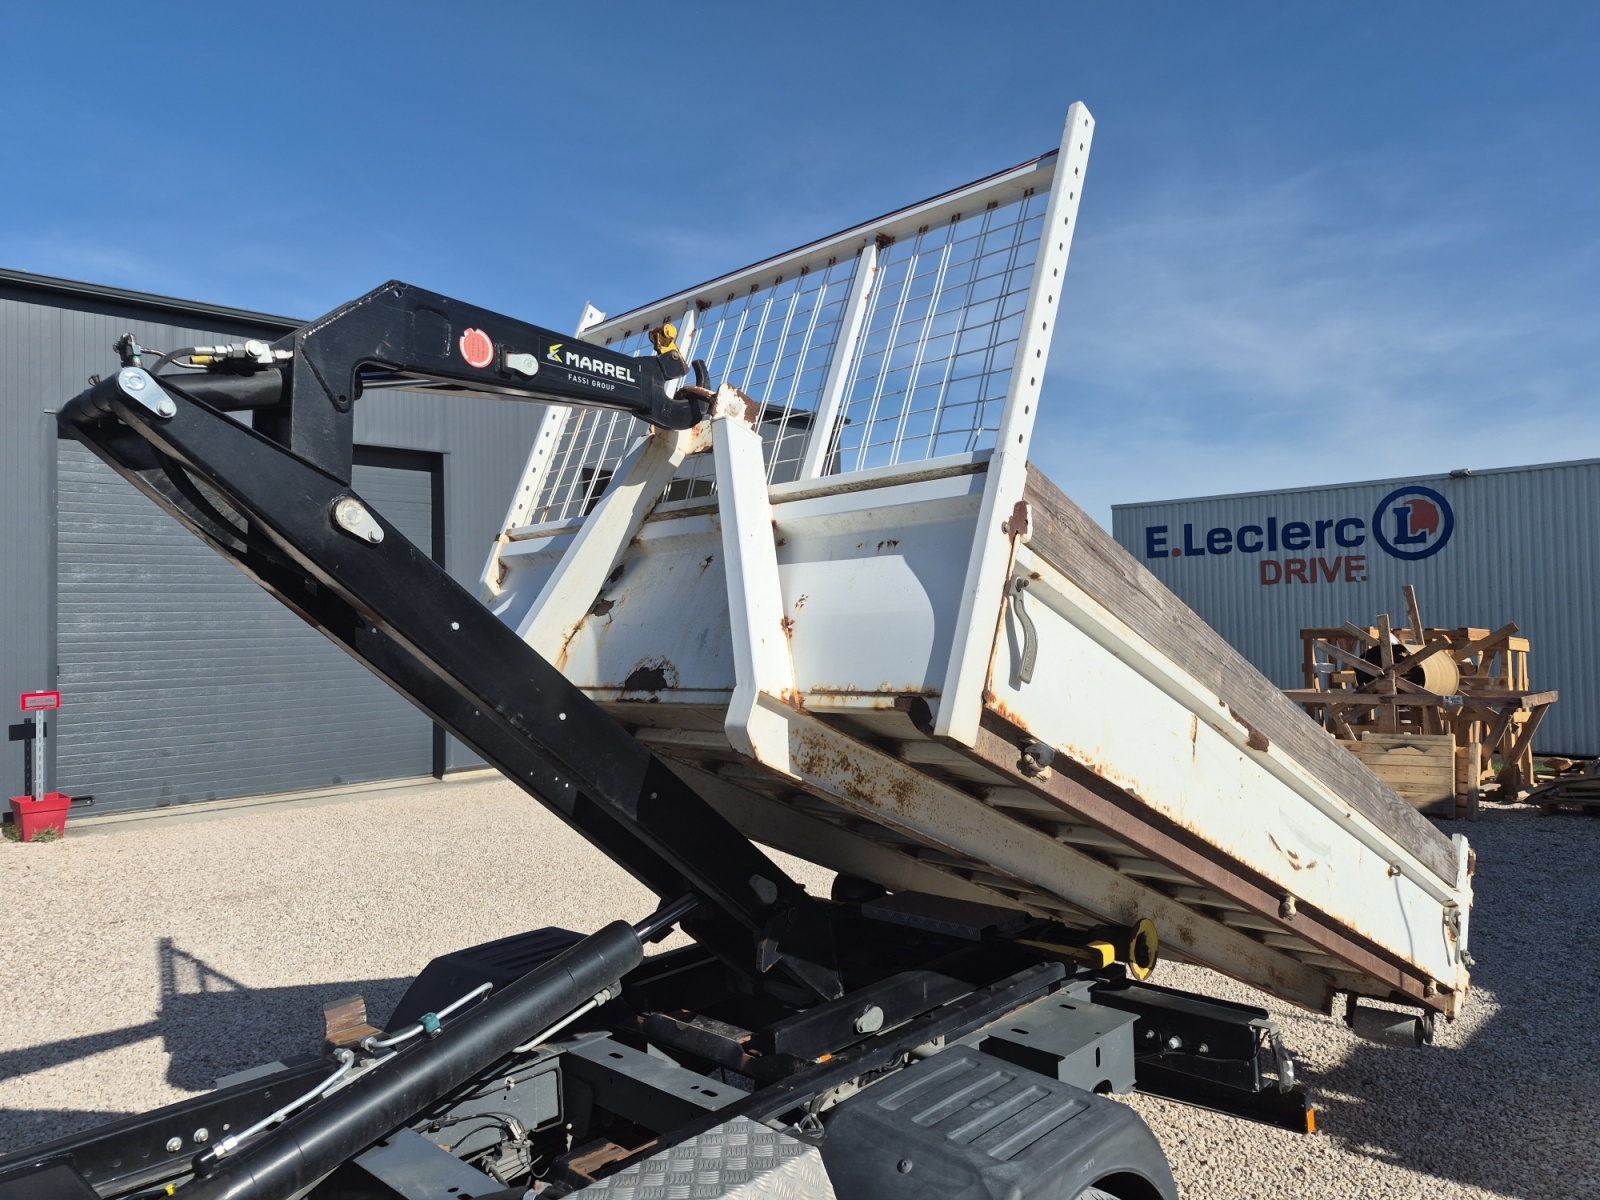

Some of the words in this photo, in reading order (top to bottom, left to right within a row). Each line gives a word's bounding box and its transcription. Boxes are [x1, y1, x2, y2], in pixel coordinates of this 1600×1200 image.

[566, 351, 636, 383] MARREL
[568, 373, 589, 385] FASSI
[592, 380, 616, 391] GROUP
[1146, 516, 1366, 559] E.Leclerc
[1393, 506, 1427, 545] L
[1260, 555, 1367, 585] DRIVE
